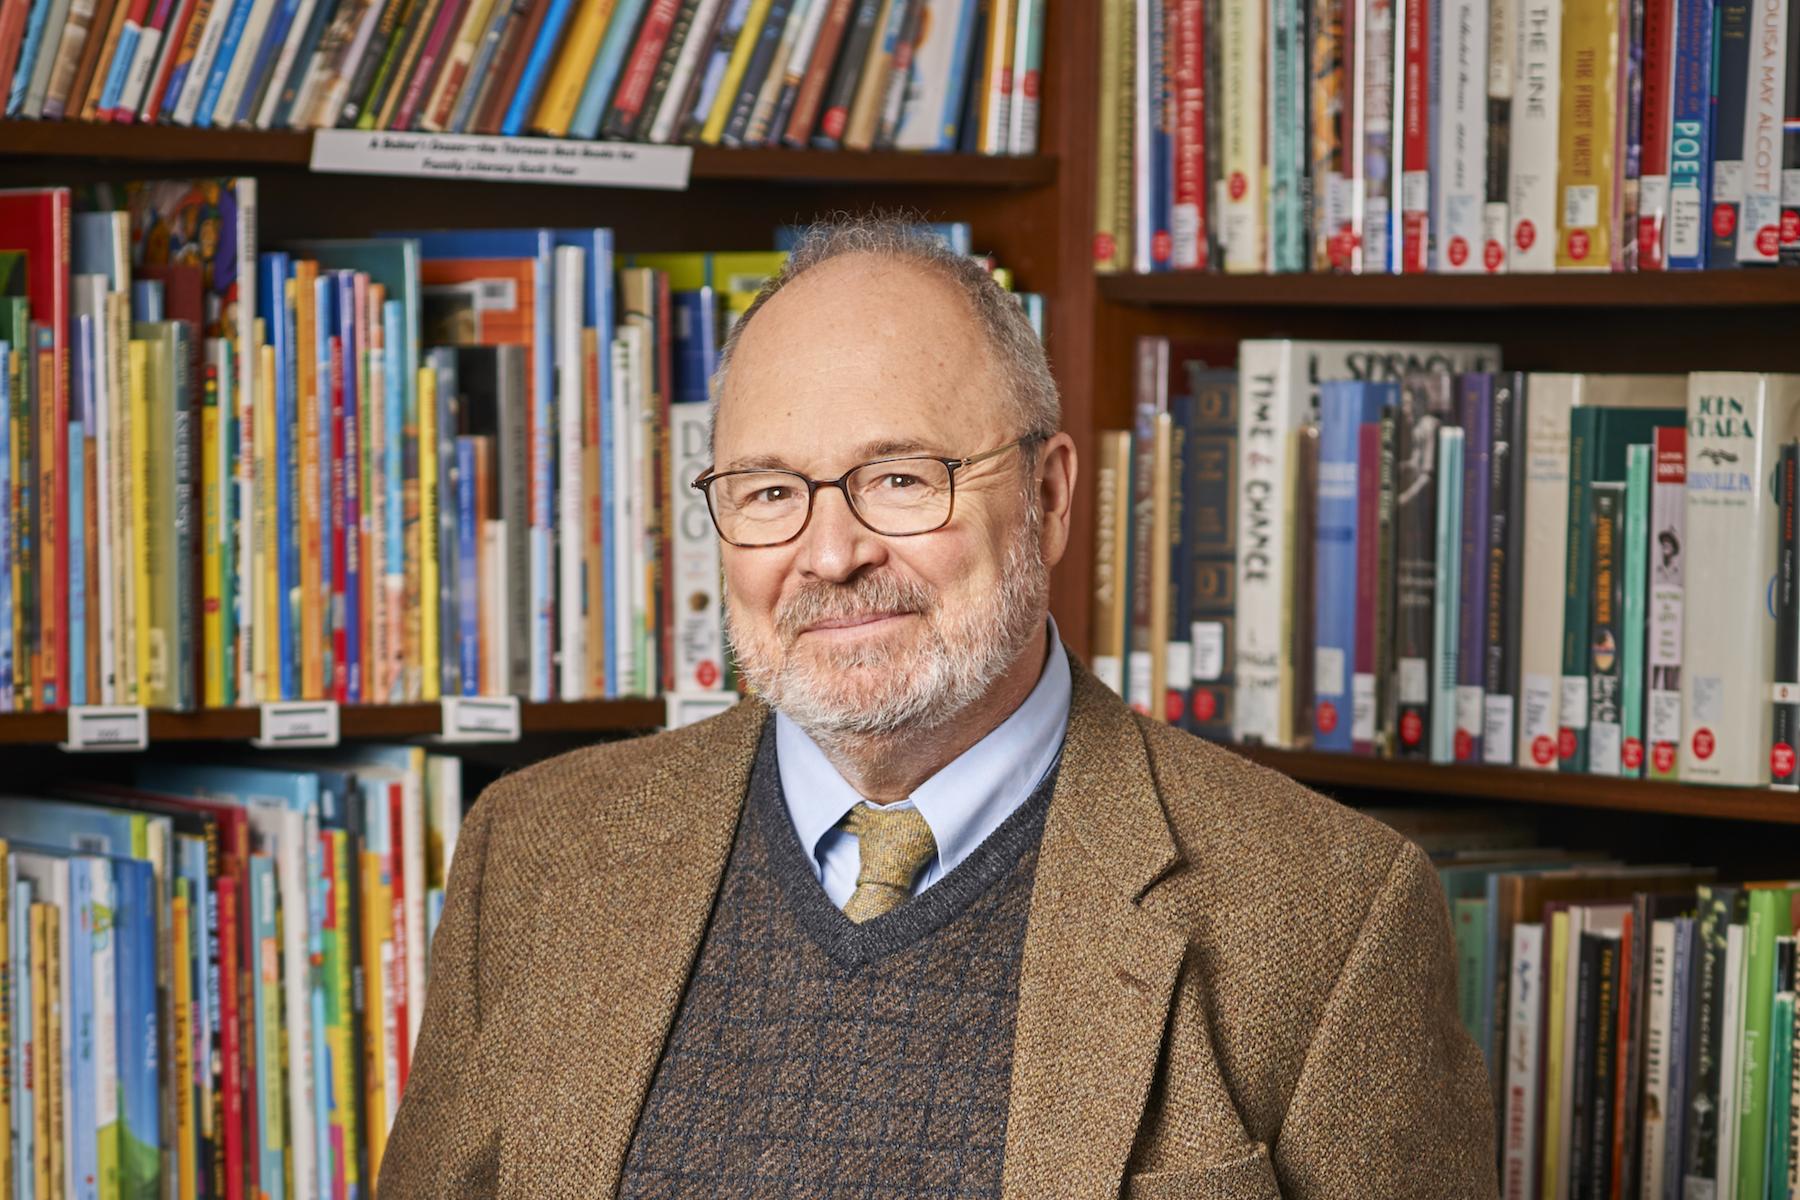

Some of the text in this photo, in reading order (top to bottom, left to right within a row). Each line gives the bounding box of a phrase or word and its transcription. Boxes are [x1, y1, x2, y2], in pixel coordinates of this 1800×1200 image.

[1526, 8, 1550, 119] THE LINE
[1759, 66, 1775, 105] MAY
[1754, 112, 1773, 192] ALCOTT
[1249, 373, 1278, 437] TIME
[1697, 395, 1744, 417] JOHN
[1244, 478, 1273, 583] CHANCE
